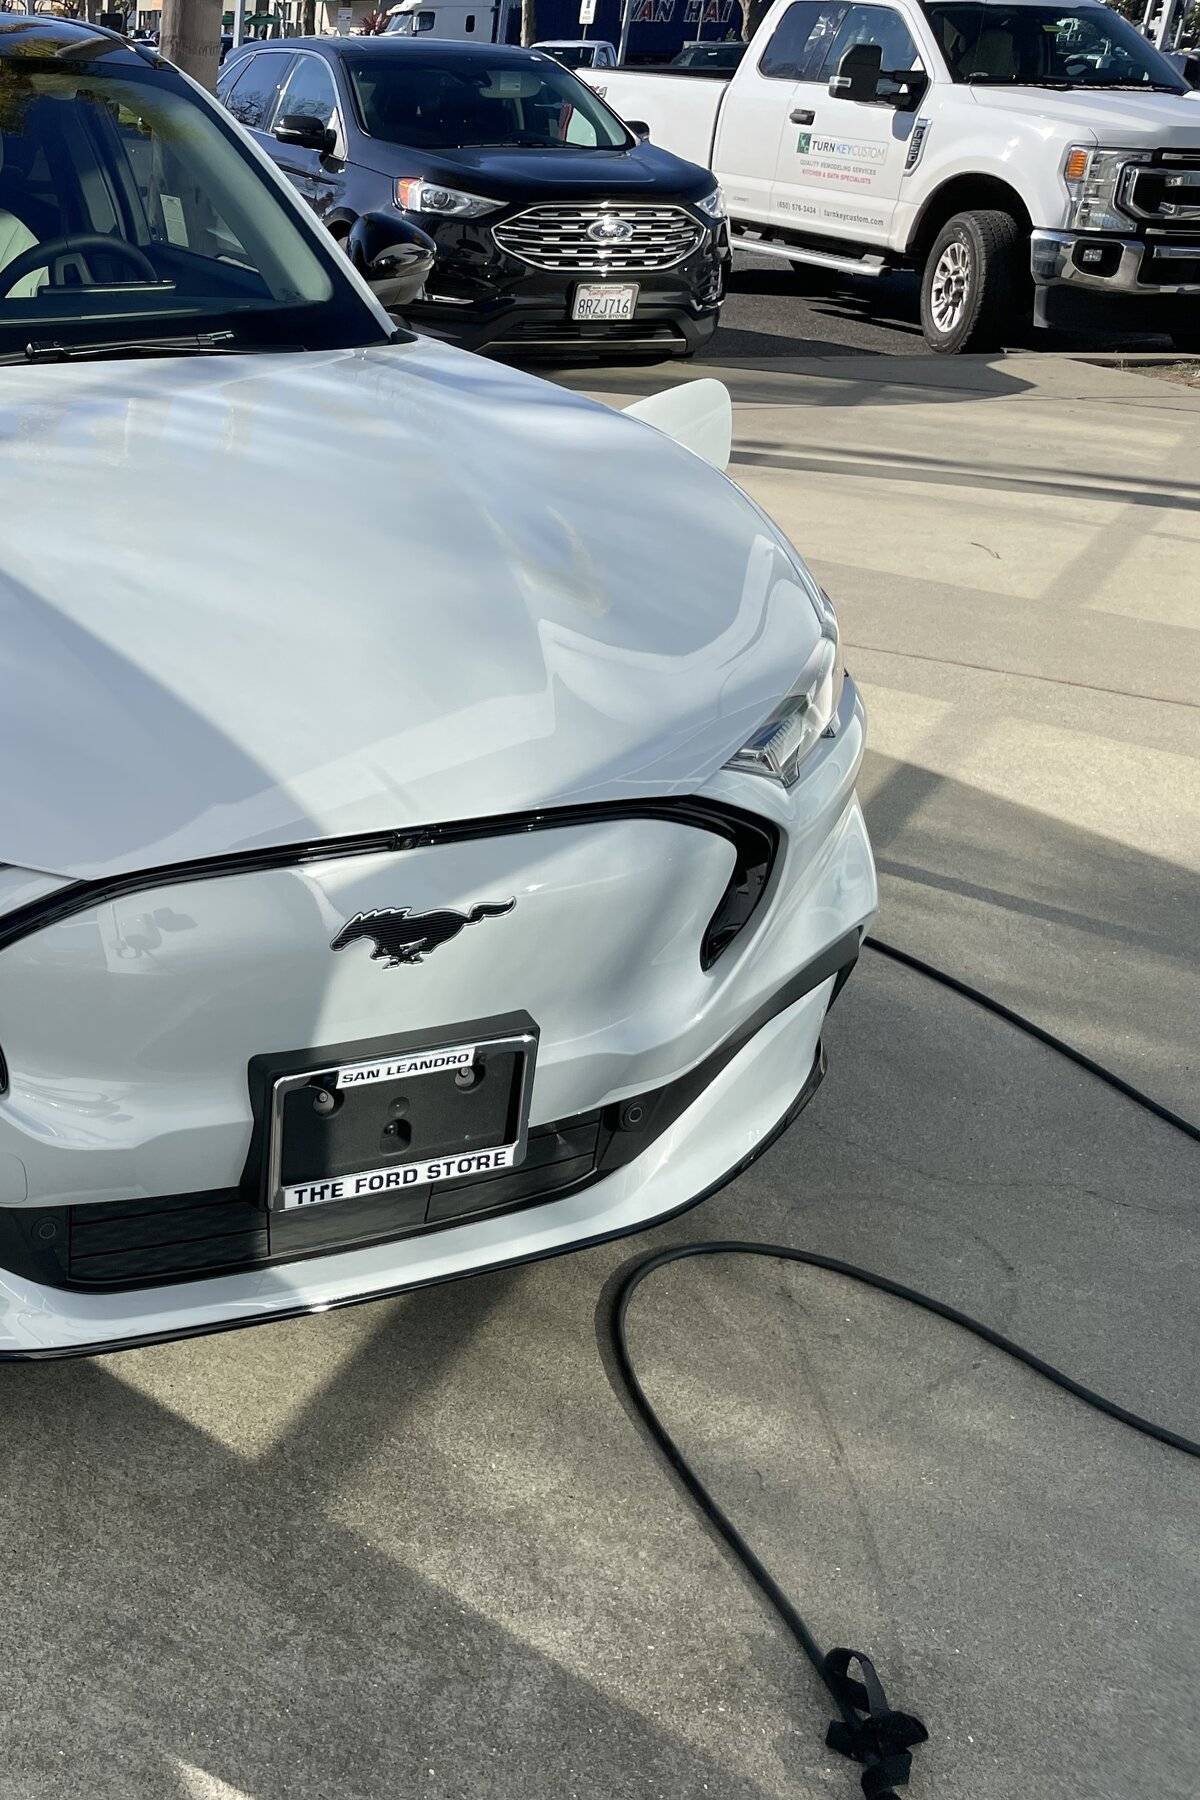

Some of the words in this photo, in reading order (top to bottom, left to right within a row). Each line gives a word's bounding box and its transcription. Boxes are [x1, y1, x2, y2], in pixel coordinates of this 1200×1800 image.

[824, 209, 884, 226] turnkeycustom.com
[578, 298, 630, 314] 8RZJ716
[341, 1069, 381, 1084] SAN
[386, 1053, 470, 1076] LEANDRO
[294, 1182, 344, 1205] THE
[354, 1168, 418, 1194] FORD
[426, 1151, 507, 1179] STORE
